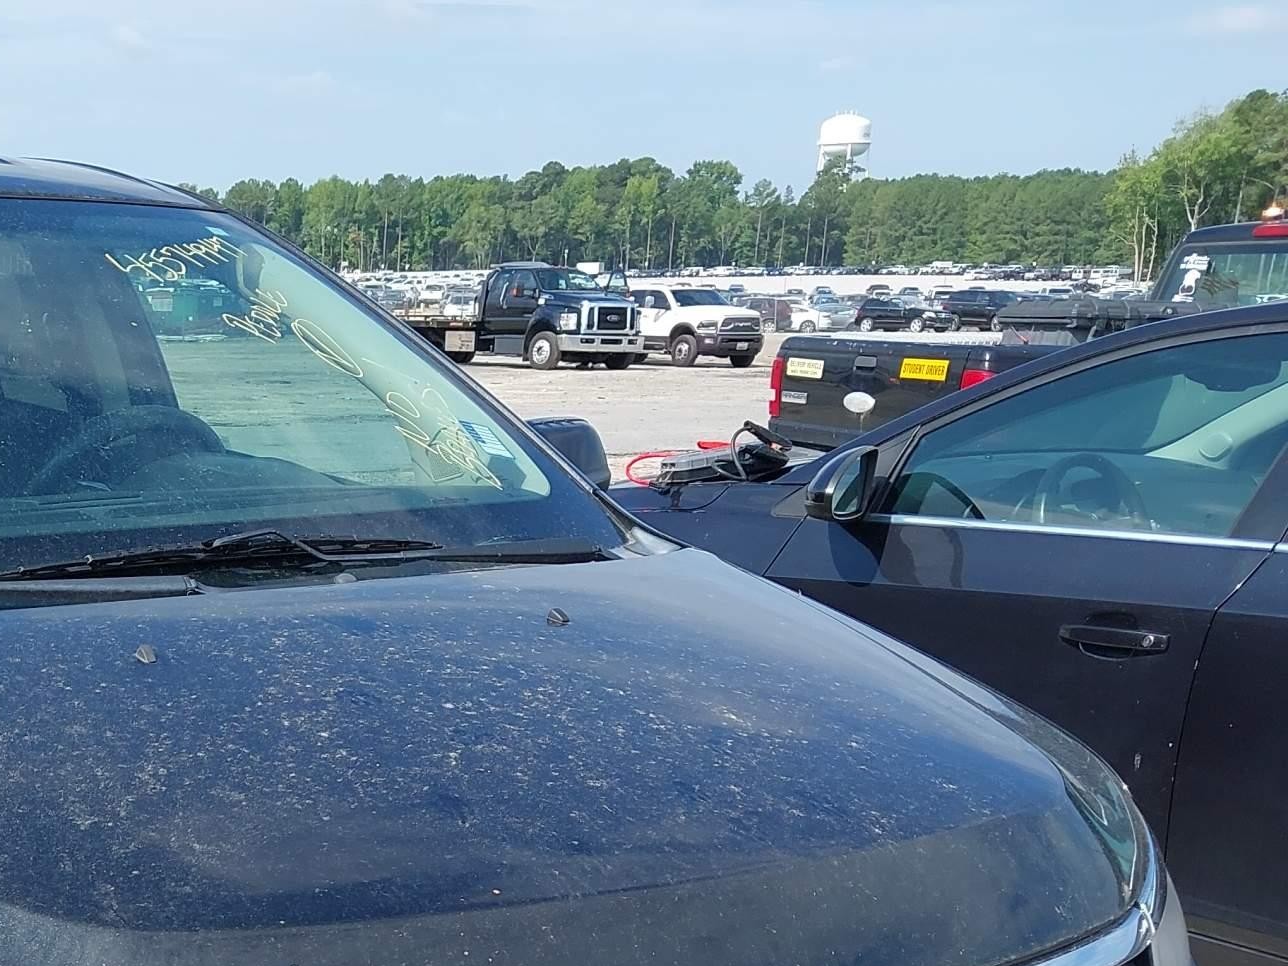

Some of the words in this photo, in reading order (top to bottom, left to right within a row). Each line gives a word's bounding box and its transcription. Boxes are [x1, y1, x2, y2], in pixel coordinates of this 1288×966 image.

[105, 236, 247, 283] 45574947
[903, 363, 925, 374] STUDENT
[925, 364, 945, 376] DRIVER
